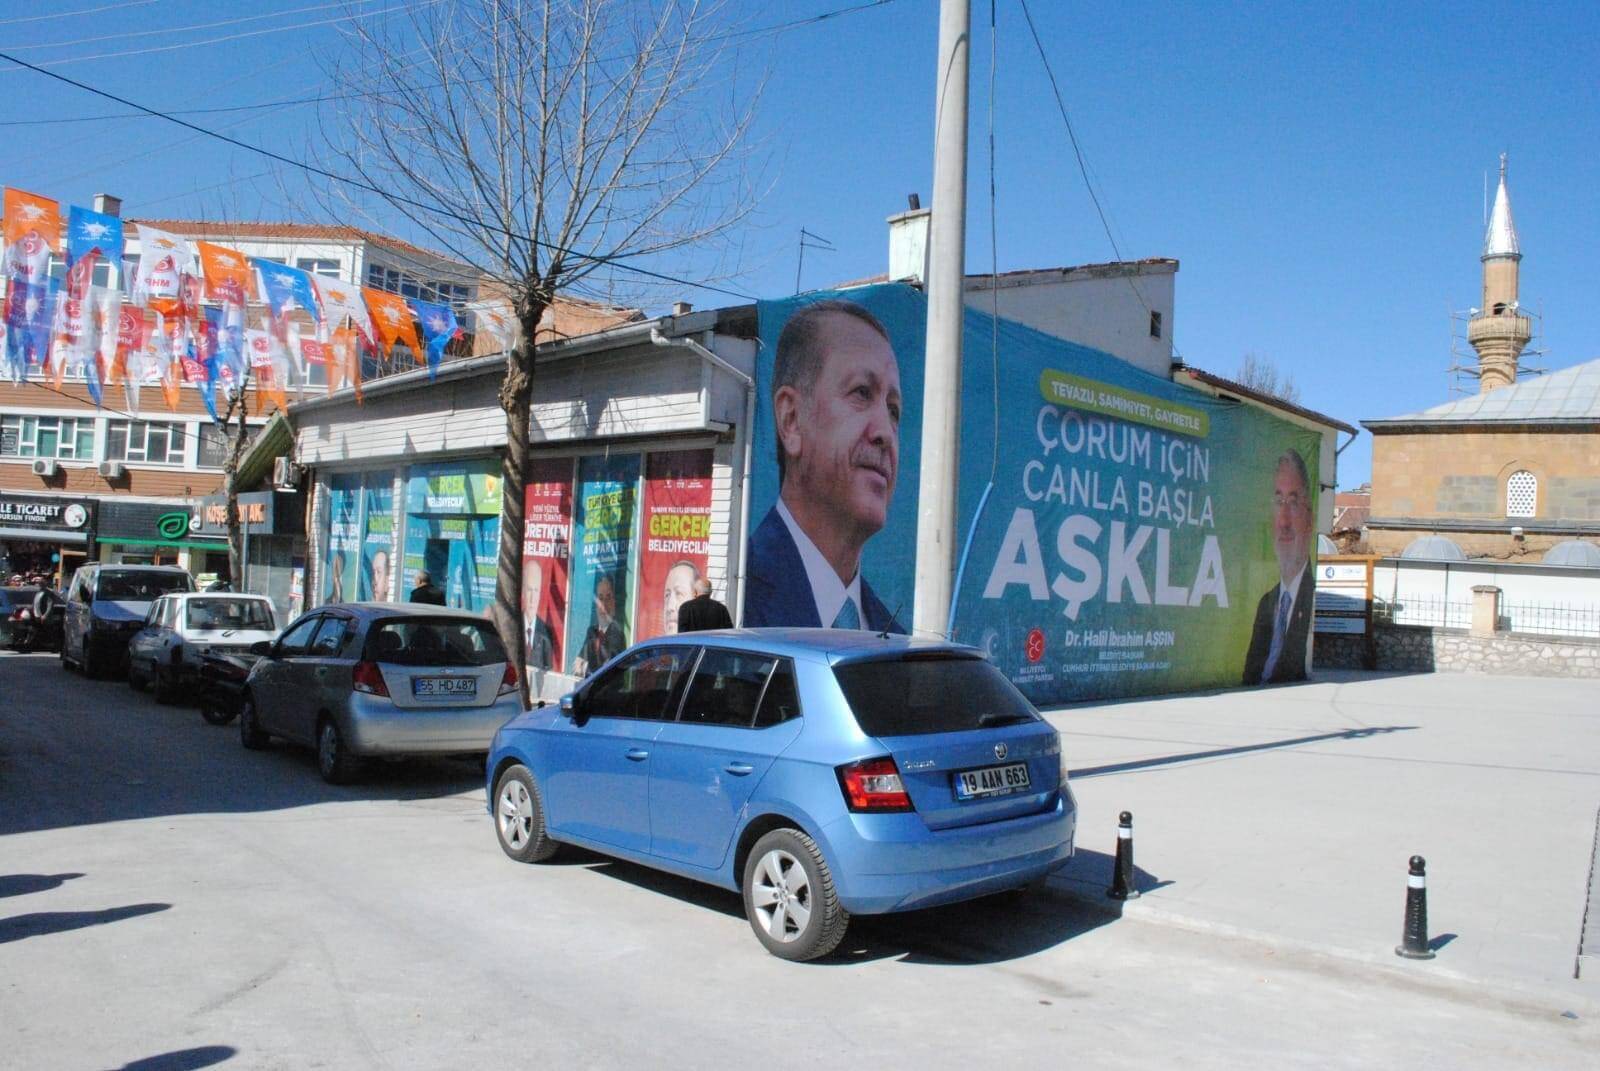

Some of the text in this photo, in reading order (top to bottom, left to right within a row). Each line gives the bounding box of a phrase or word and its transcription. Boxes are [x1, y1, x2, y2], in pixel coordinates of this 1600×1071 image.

[1052, 381, 1097, 407] TEVAZU,
[1155, 408, 1200, 431] GAYRETLE
[1036, 405, 1210, 483] ÇORUM İÇİN
[1022, 459, 1215, 529] CANLA BAŞLA
[0, 513, 23, 521] URSUN
[649, 513, 710, 539] GERÇEK
[982, 507, 1230, 622] AŞKLA
[1065, 630, 1082, 646] Dr.
[1083, 630, 1108, 646] Halil
[456, 680, 473, 690] 487
[962, 774, 978, 793] 19
[981, 769, 1003, 789] AAN
[1005, 767, 1027, 785] 663
